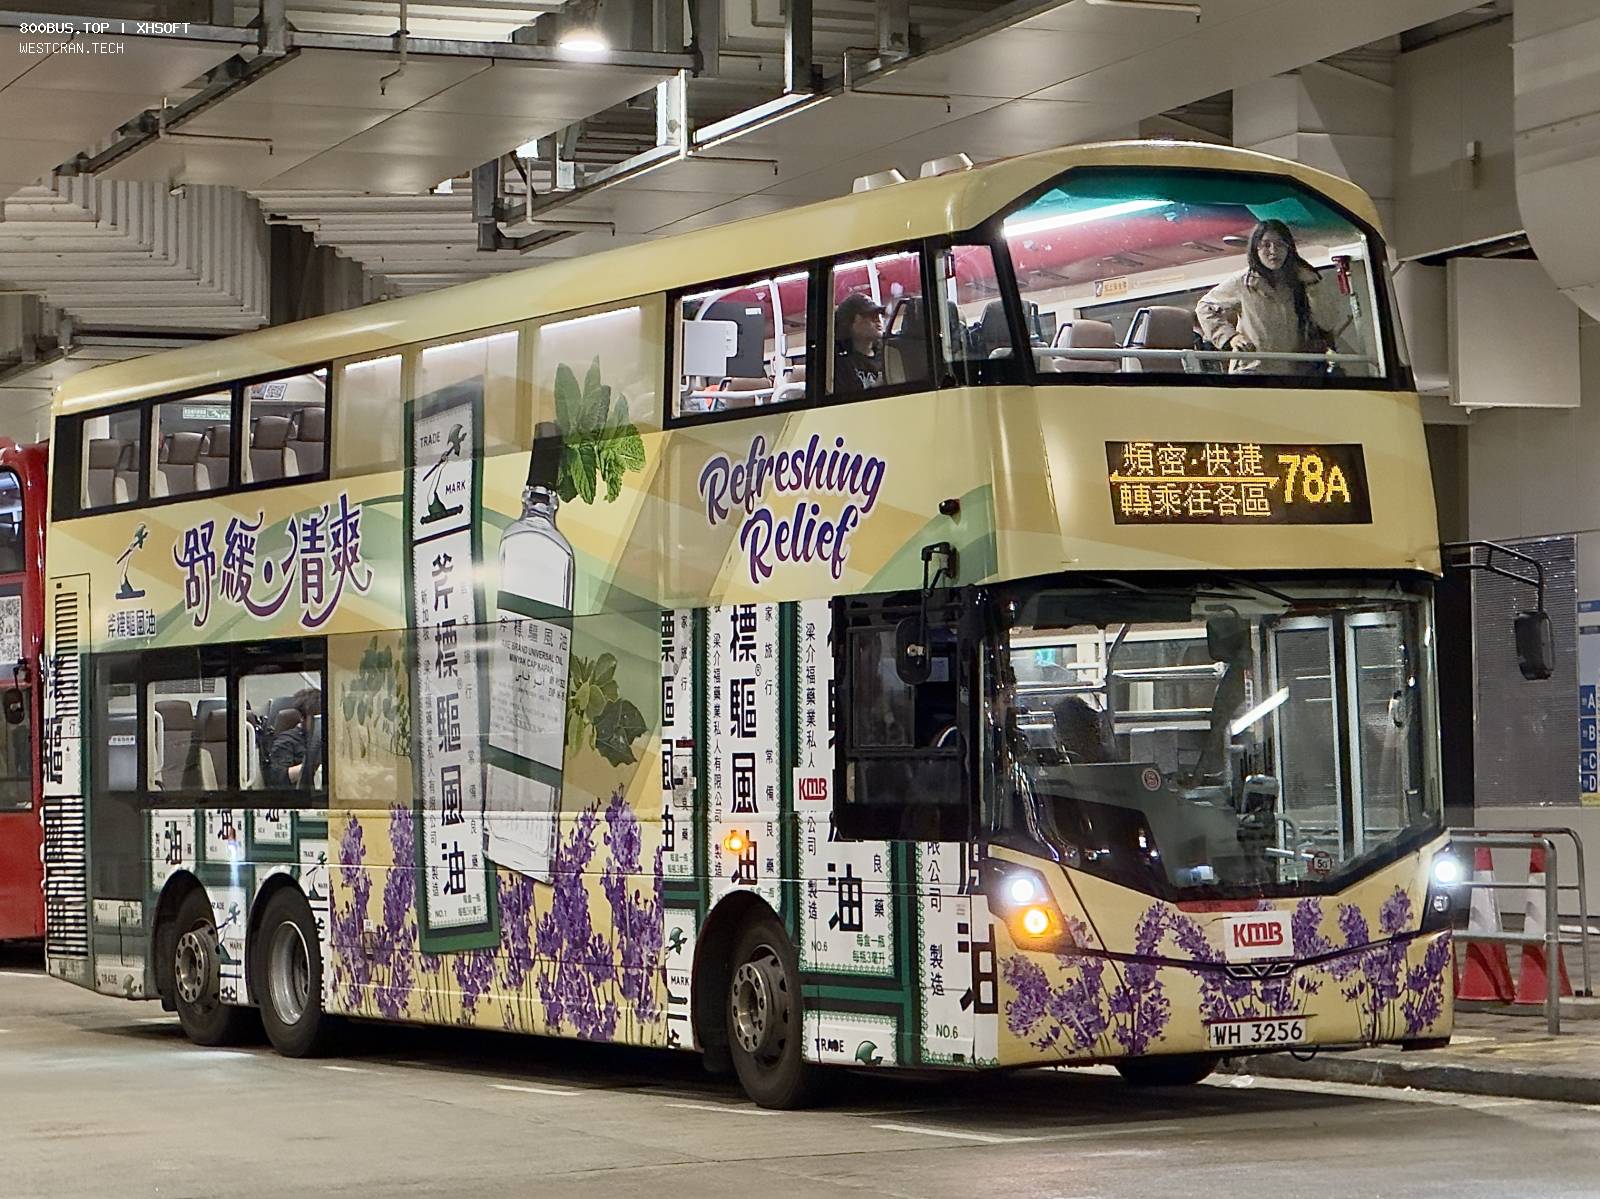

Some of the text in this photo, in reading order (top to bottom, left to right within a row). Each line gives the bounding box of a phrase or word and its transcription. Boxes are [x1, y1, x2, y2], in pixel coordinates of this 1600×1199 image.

[419, 430, 441, 449] TRADE
[444, 480, 467, 495] MARK
[699, 433, 886, 526] Refreshing
[1278, 453, 1351, 503] 78A
[1119, 482, 1271, 517] 轉乘往各區
[739, 502, 859, 585] Relief
[1588, 693, 1596, 709] A
[1589, 725, 1596, 741] B
[1589, 754, 1597, 769] C
[799, 778, 828, 801] KMB
[1590, 776, 1597, 791] D
[828, 863, 864, 933] 油
[1233, 921, 1284, 948] KMB
[811, 940, 828, 952] NO.6
[670, 975, 690, 986] MARK
[929, 944, 945, 997] 製造
[935, 1023, 959, 1040] NO.6
[1214, 1021, 1303, 1046] WH 3256
